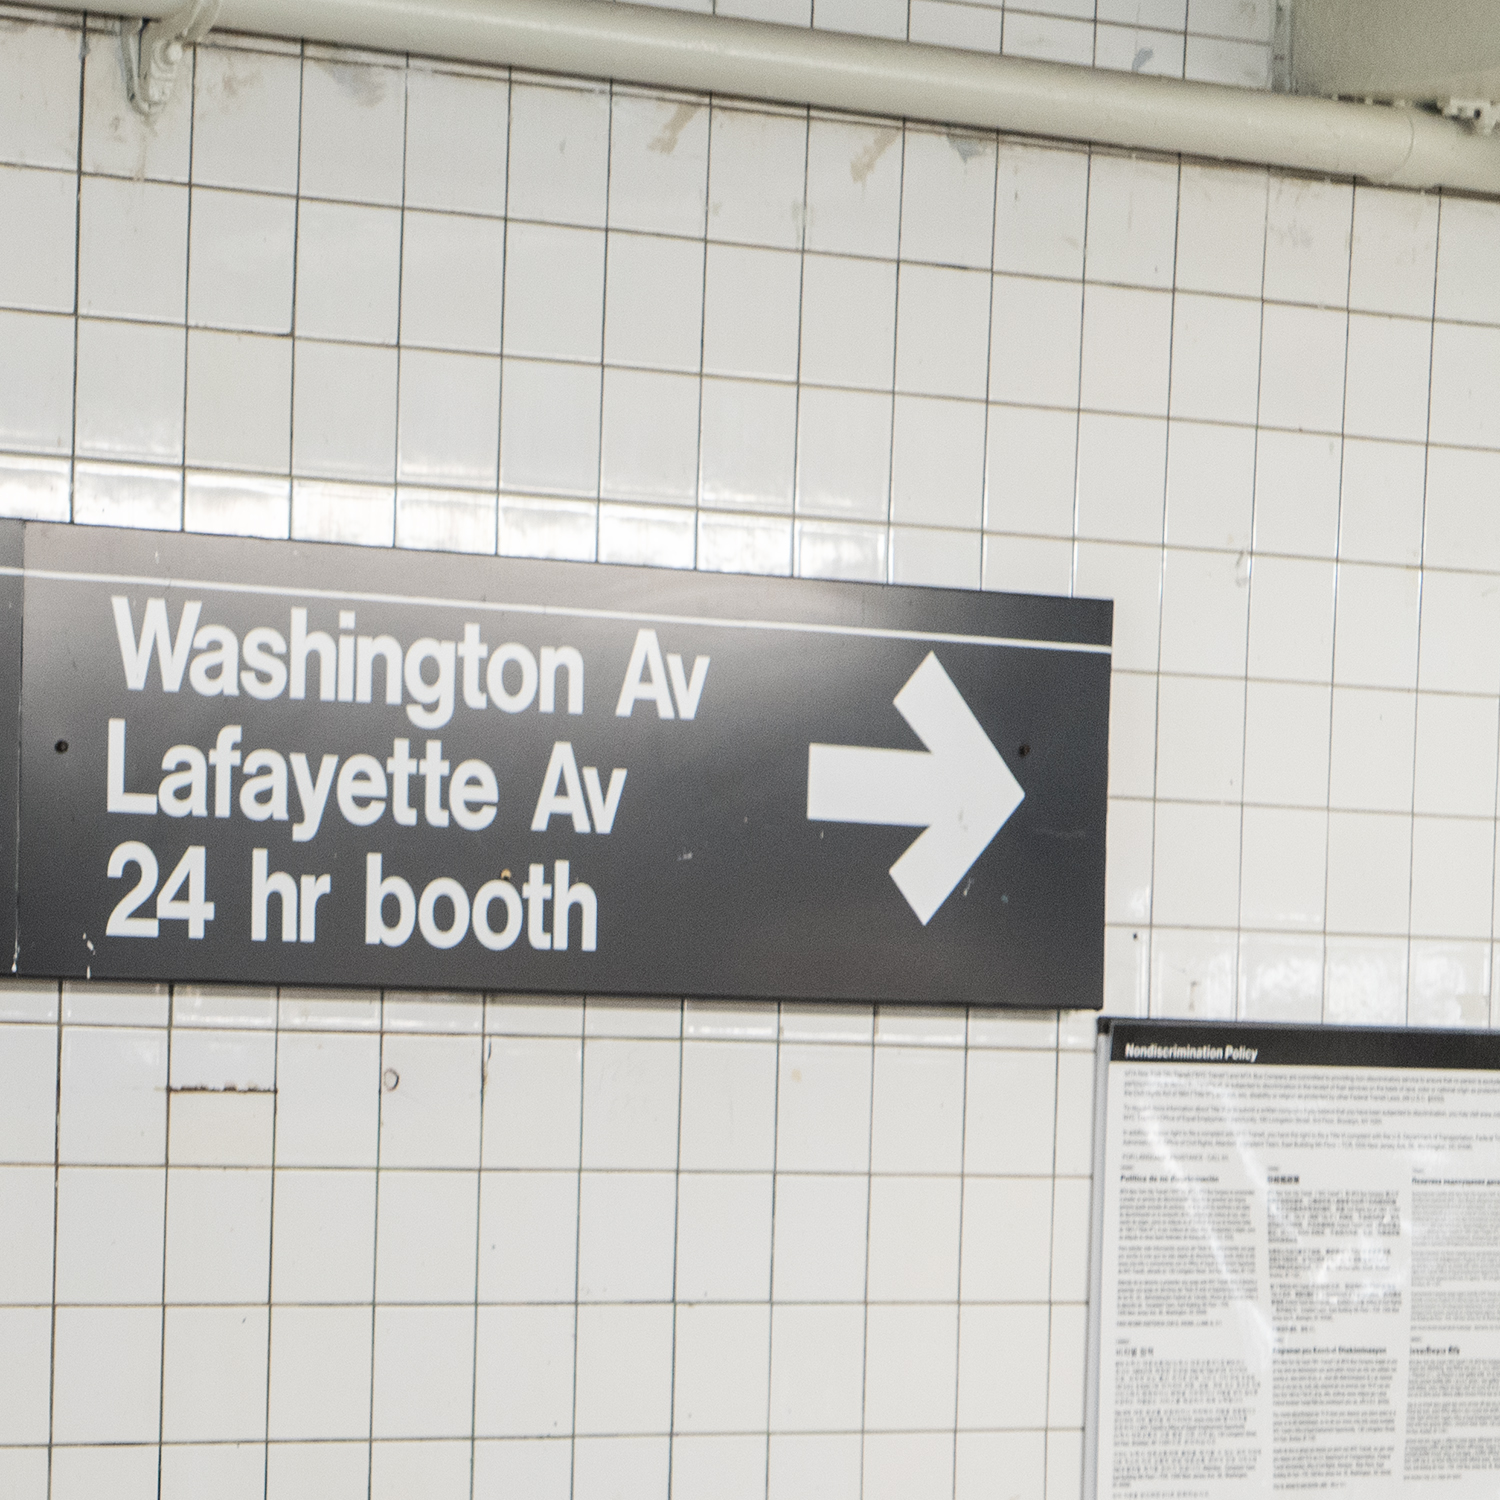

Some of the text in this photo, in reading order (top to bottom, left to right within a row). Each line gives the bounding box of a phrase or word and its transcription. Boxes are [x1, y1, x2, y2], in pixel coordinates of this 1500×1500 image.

[110, 595, 710, 729] Washington Av
[106, 718, 628, 842] Lafayette Av
[105, 840, 597, 952] 24 hr booth
[1125, 1042, 1258, 1063] Nondiscrimination Policy
